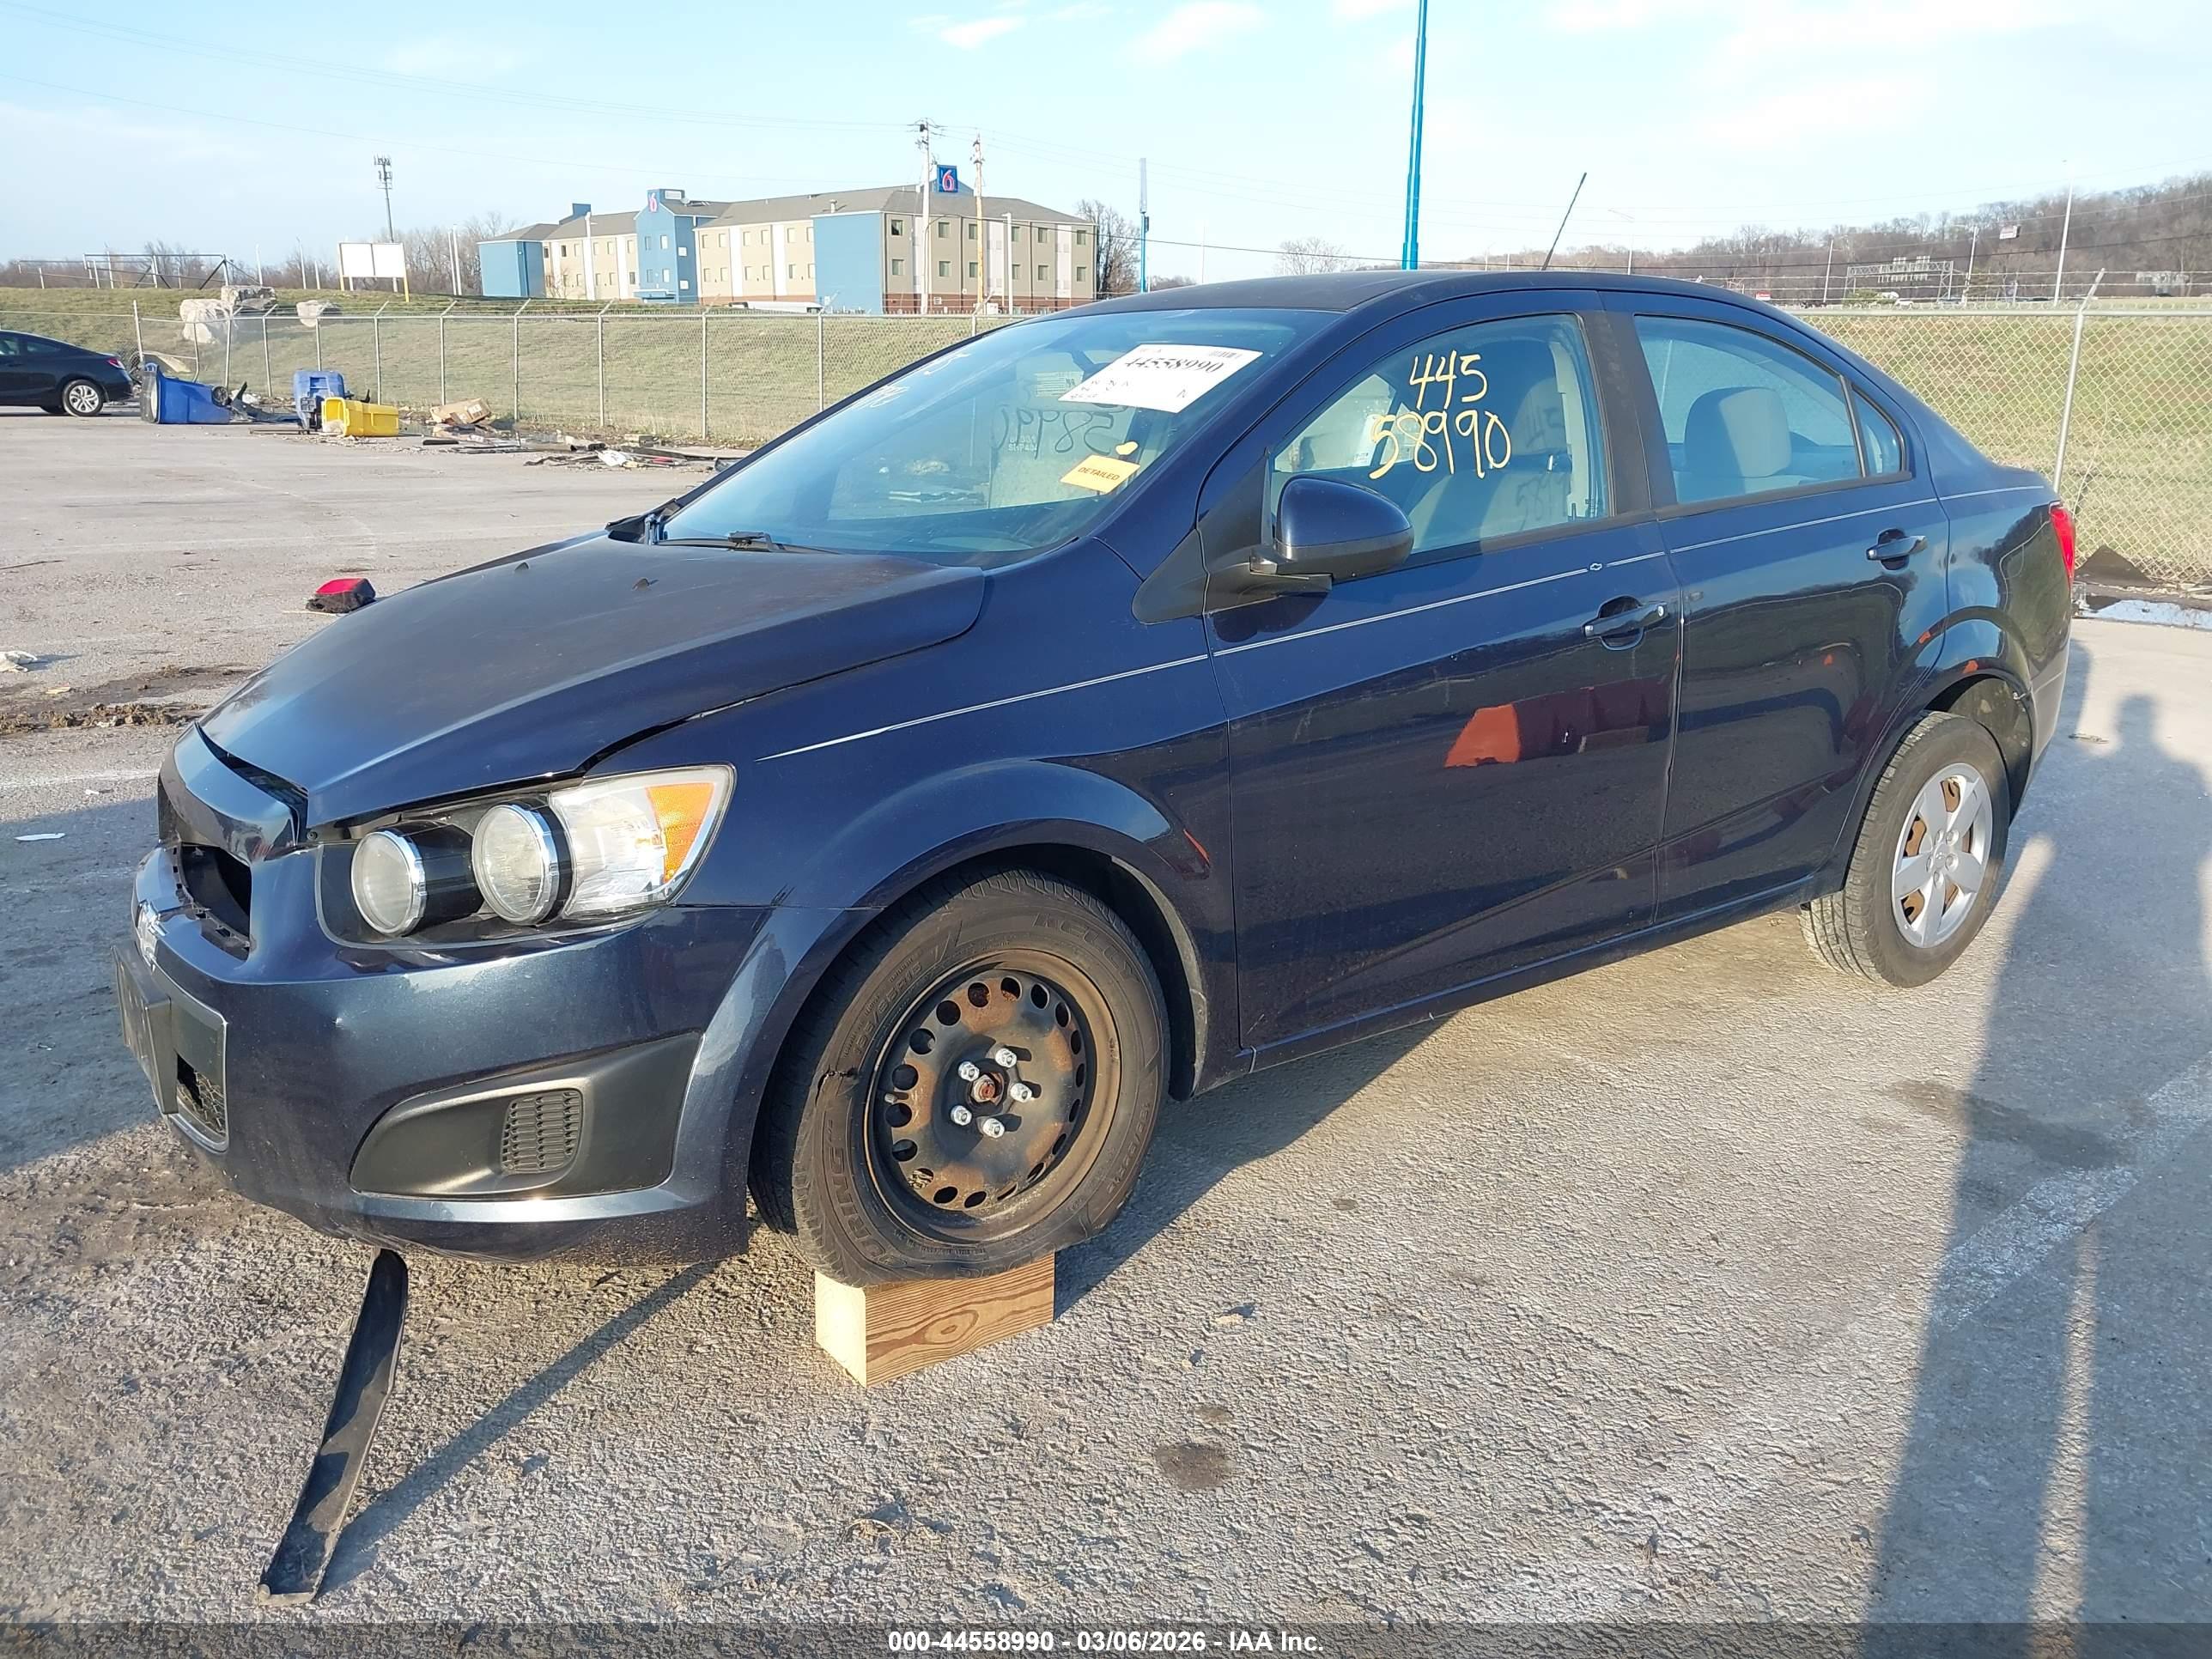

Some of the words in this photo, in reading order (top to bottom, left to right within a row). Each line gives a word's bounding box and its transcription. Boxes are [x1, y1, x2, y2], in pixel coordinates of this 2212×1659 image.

[942, 169, 955, 191] 6
[649, 192, 658, 213] 6
[1125, 356, 1224, 374] 44558990
[1409, 349, 1488, 410] 445
[1369, 409, 1511, 479] 58990
[1078, 466, 1121, 482] DETAILED
